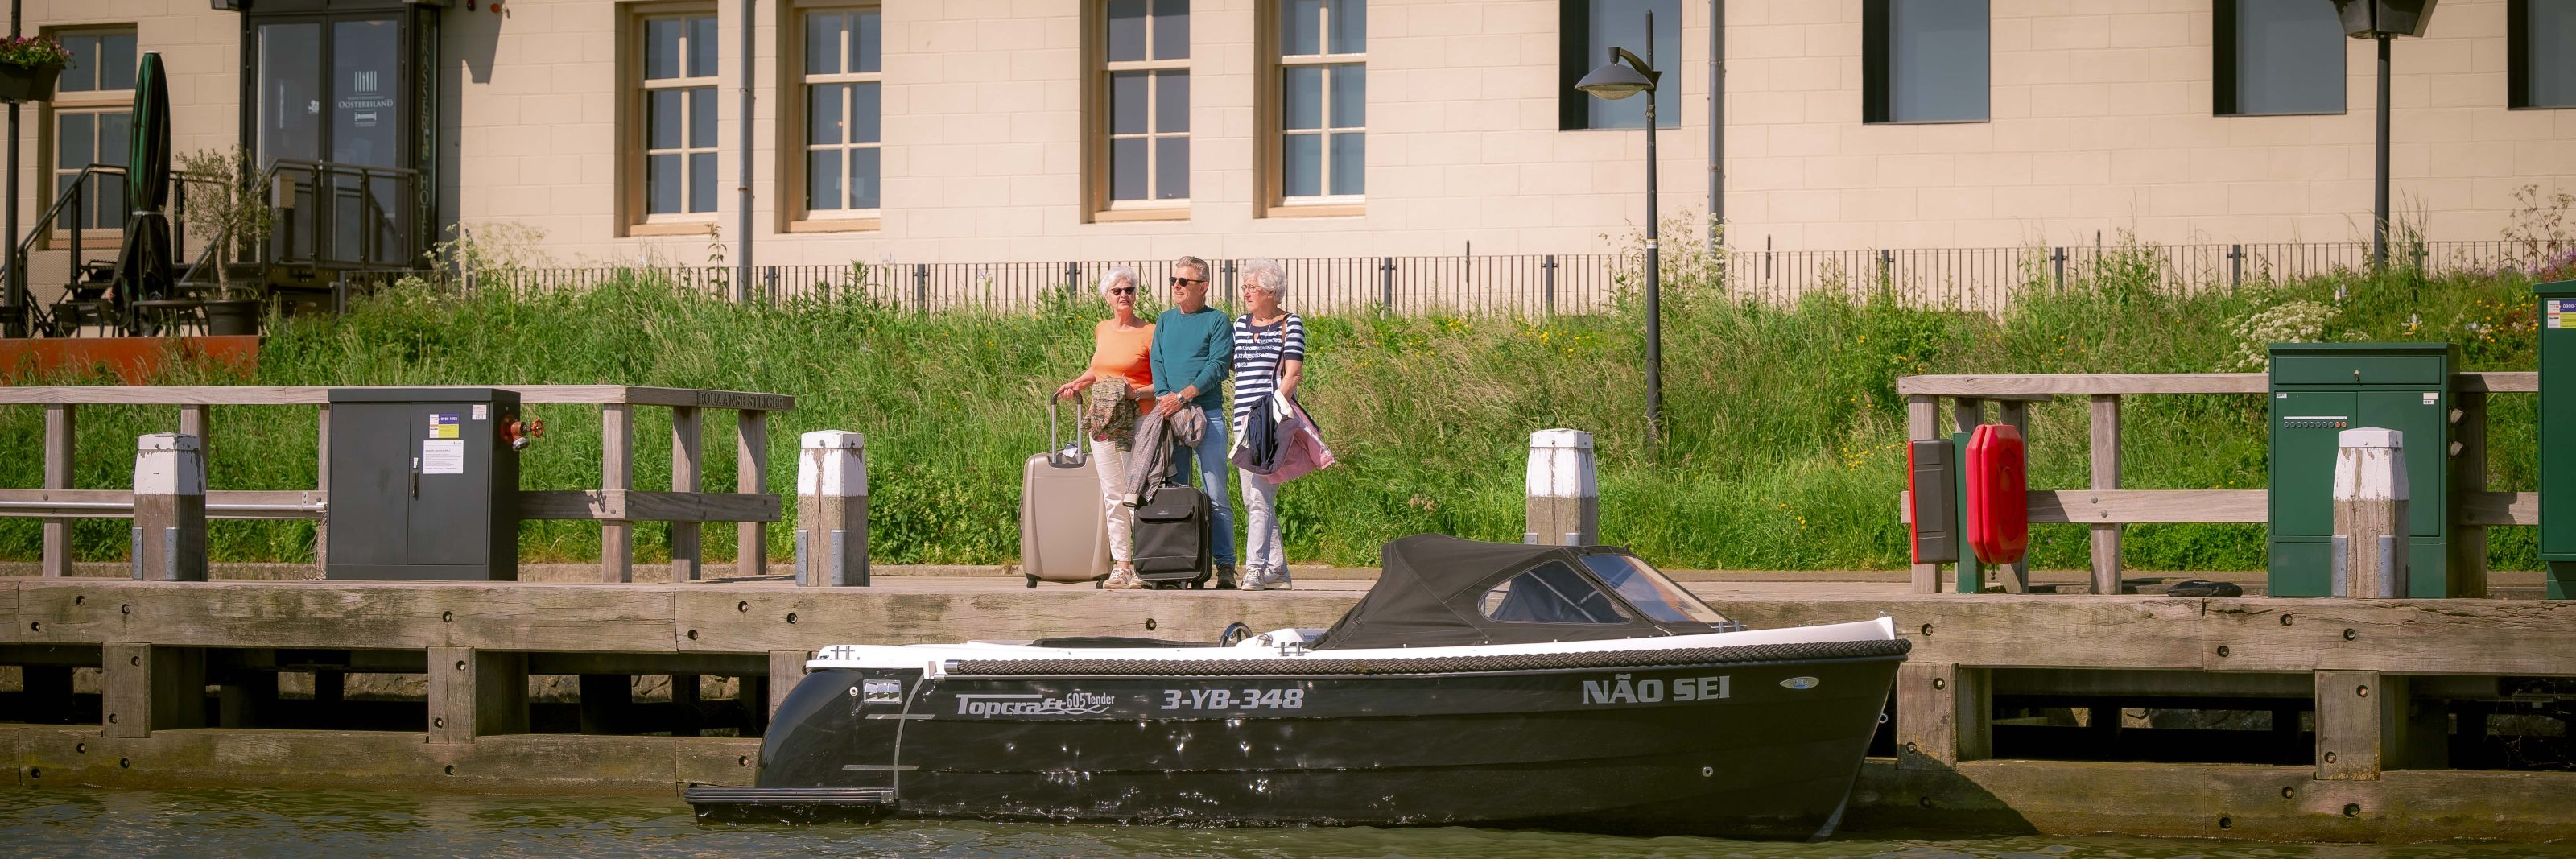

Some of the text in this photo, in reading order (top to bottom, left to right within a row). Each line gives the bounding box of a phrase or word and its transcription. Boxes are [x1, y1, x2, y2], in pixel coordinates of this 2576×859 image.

[338, 99, 394, 109] OOSTEREILAND
[419, 175, 429, 250] HOTEL
[749, 394, 784, 410] STEIGER
[1161, 688, 1305, 710] 3-YB-348
[1583, 673, 1731, 704] NÃO SEI
[956, 692, 1115, 719] Topcraft 605 Tender
